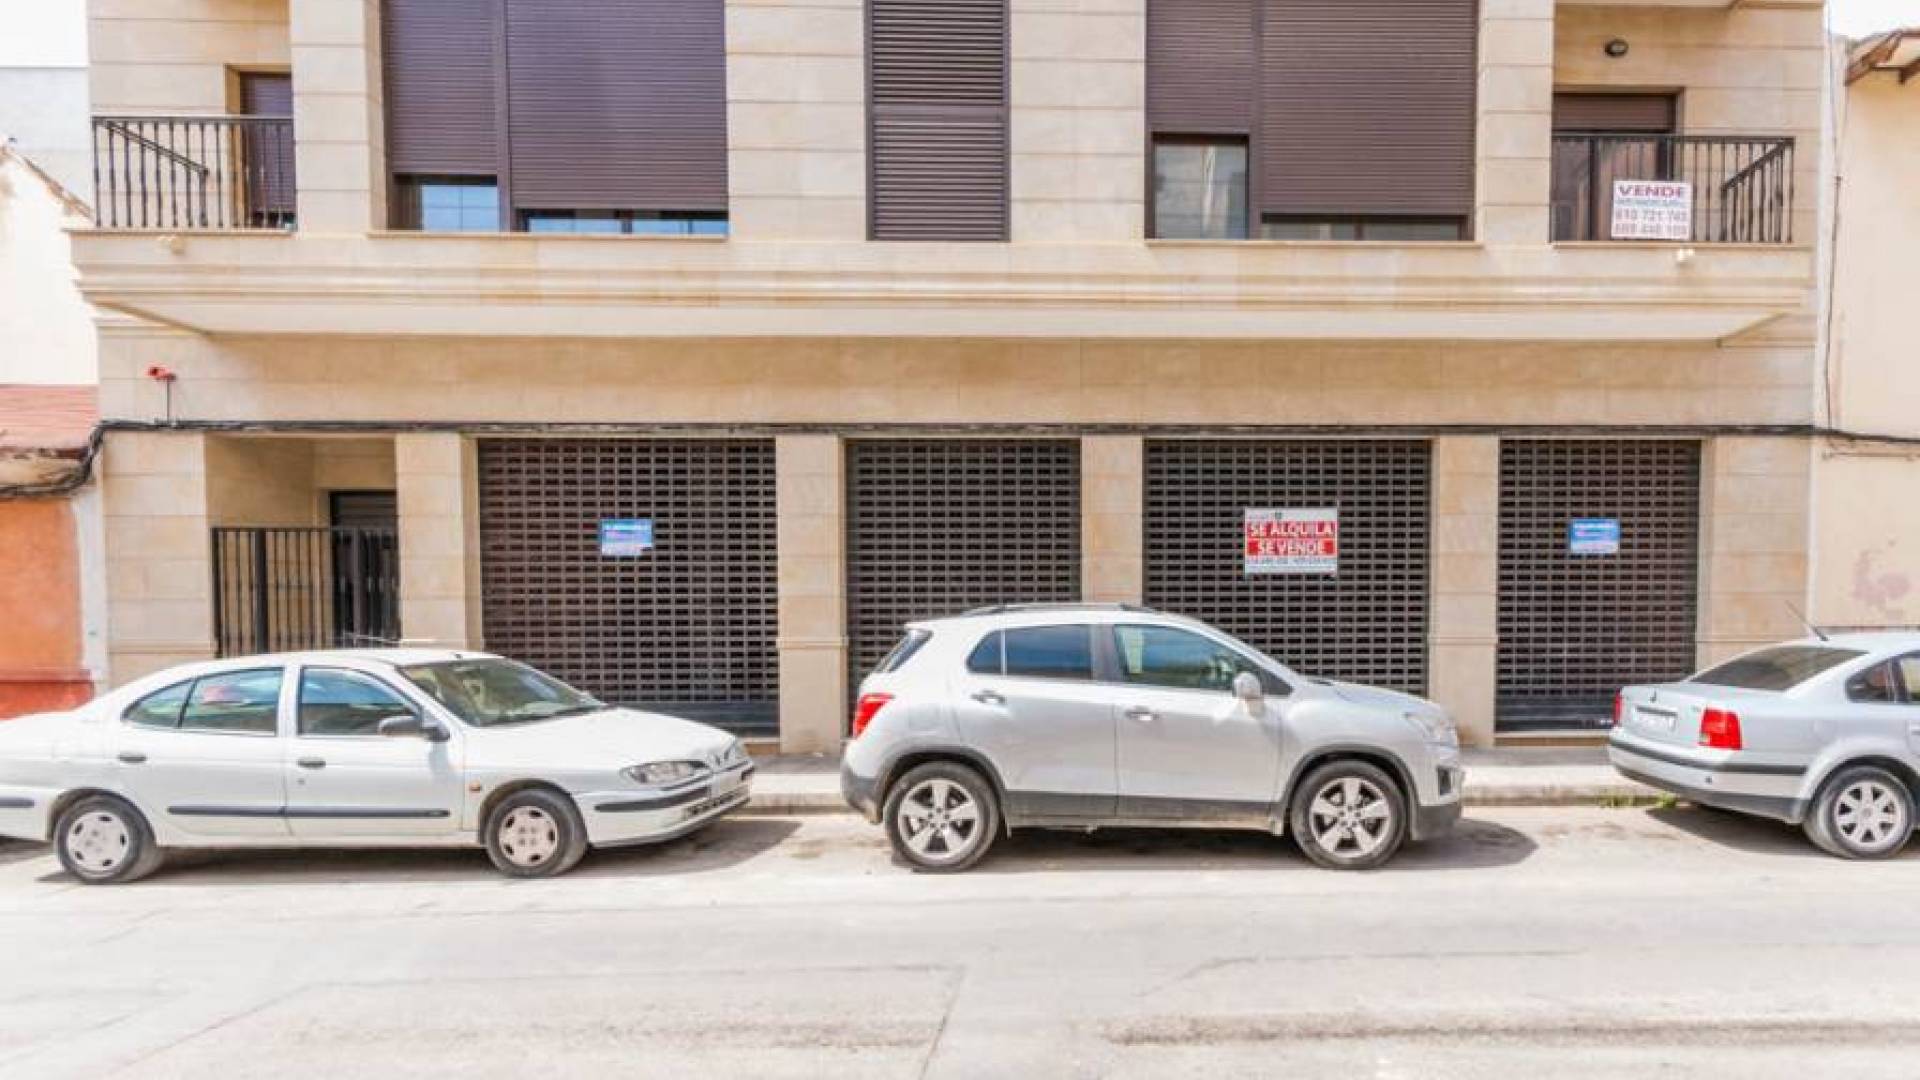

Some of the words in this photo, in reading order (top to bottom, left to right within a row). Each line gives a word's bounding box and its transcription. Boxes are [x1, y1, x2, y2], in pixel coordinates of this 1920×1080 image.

[1618, 184, 1686, 198] VENDE
[1250, 522, 1266, 537] SE
[1270, 521, 1335, 537] ALQUILA
[1258, 540, 1274, 555] SE
[1276, 539, 1325, 555] VENDE
